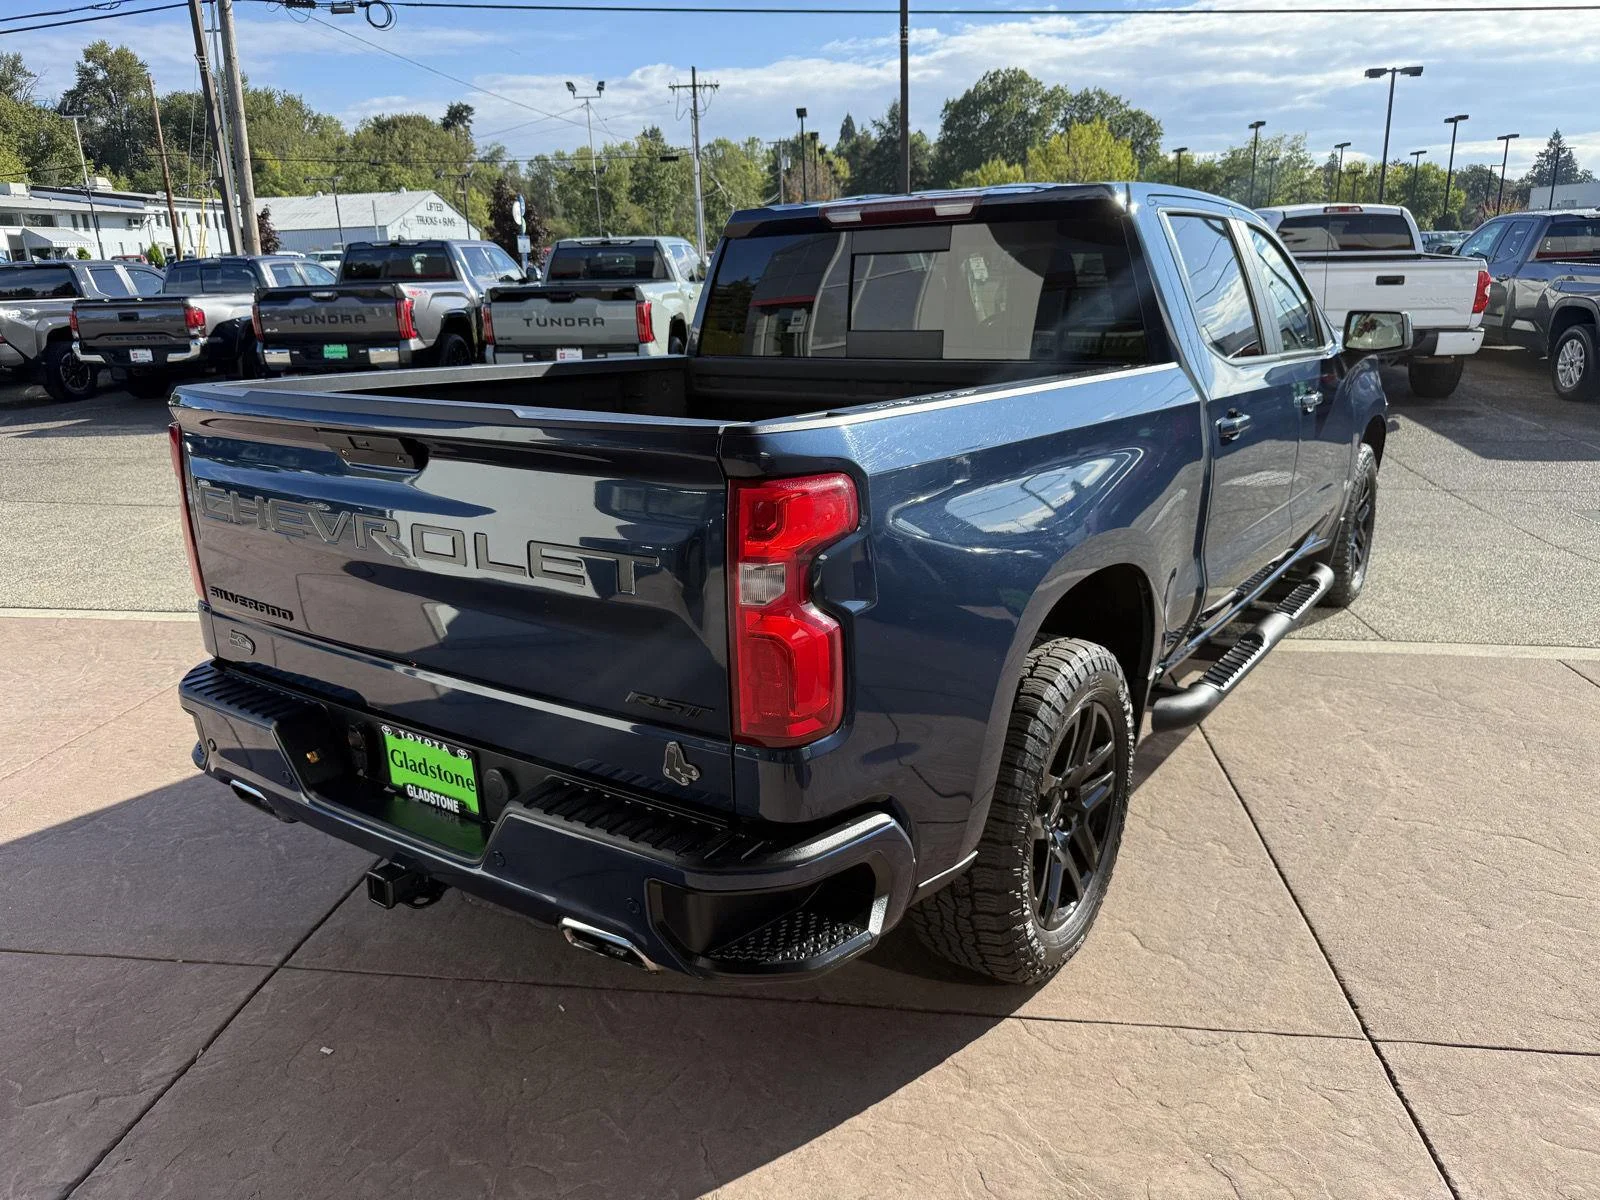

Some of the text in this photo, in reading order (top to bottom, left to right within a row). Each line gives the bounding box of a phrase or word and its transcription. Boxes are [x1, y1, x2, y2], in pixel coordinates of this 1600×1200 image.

[289, 314, 367, 325] TUNDRA
[523, 317, 606, 328] TUNDRA
[198, 484, 660, 595] CHEVROLET
[209, 585, 294, 621] SILVERADO
[625, 690, 716, 719] RST
[398, 730, 451, 755] TOYOTA
[390, 748, 476, 793] Gladstone
[406, 784, 460, 814] GLADSTONE
